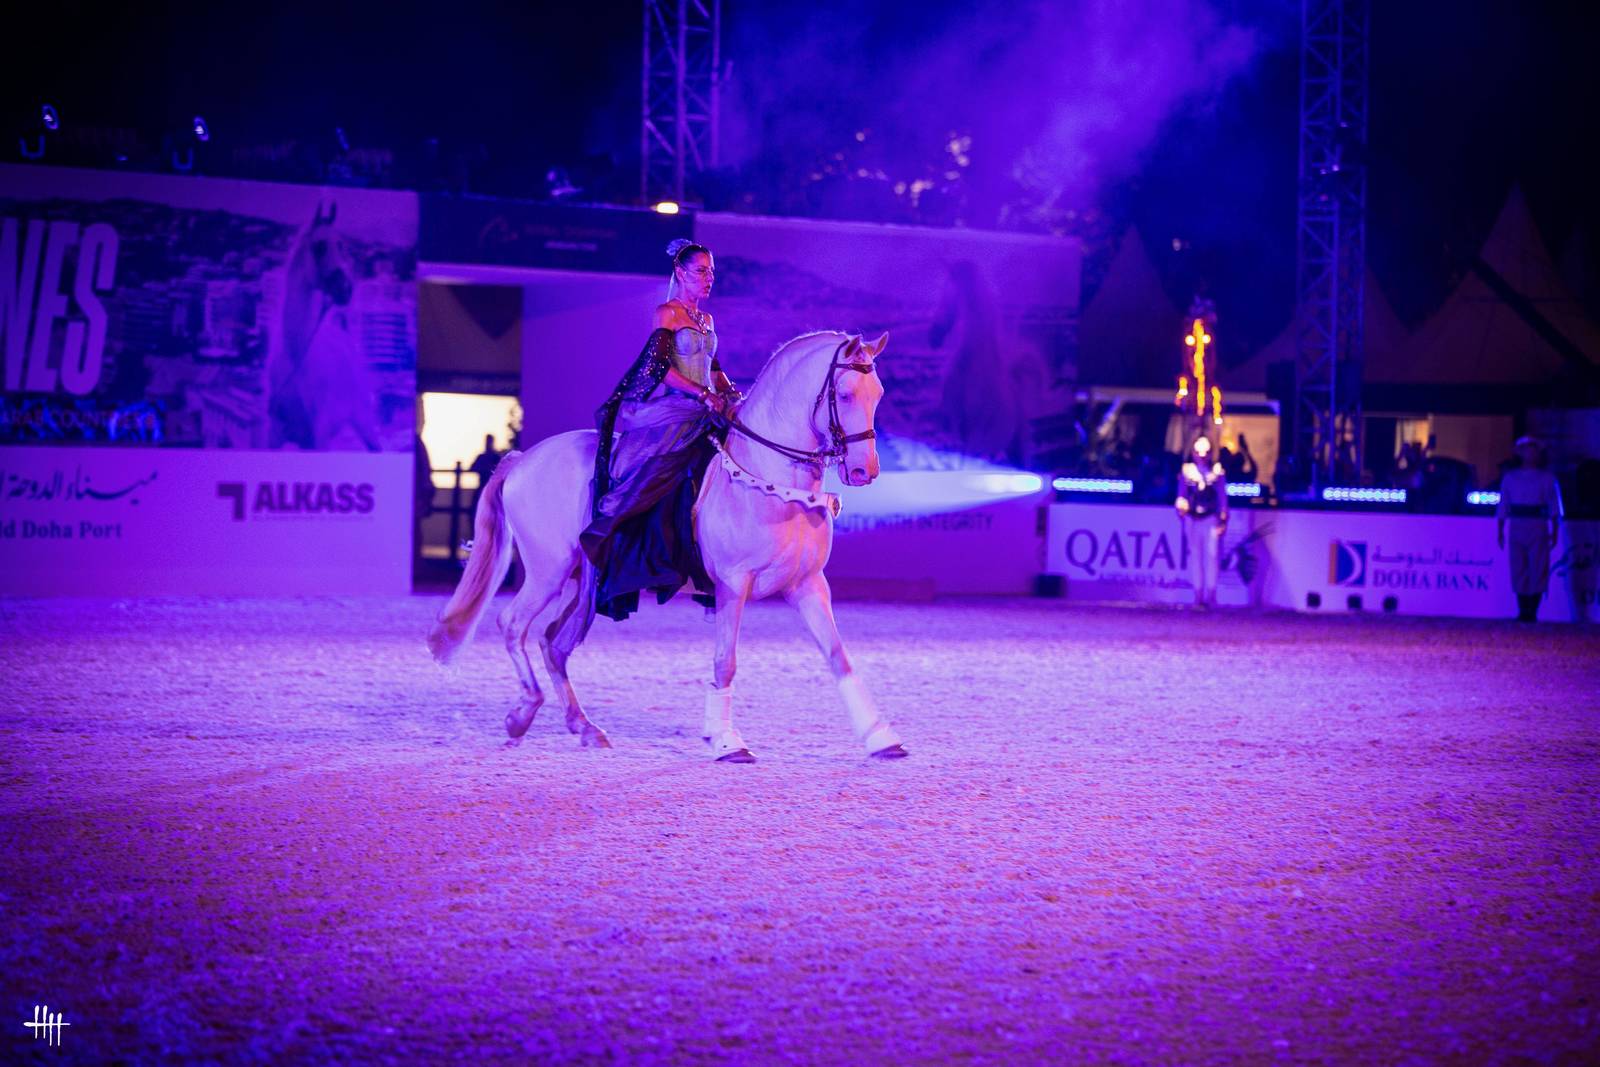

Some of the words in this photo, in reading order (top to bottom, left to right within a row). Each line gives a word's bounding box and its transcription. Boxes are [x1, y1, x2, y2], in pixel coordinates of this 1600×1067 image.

[254, 481, 375, 514] ALKASS
[22, 520, 73, 538] Doha
[79, 521, 122, 538] Port
[916, 511, 993, 531] INTEGRITY
[1372, 568, 1431, 590] DOHA
[1436, 571, 1490, 592] BANK
